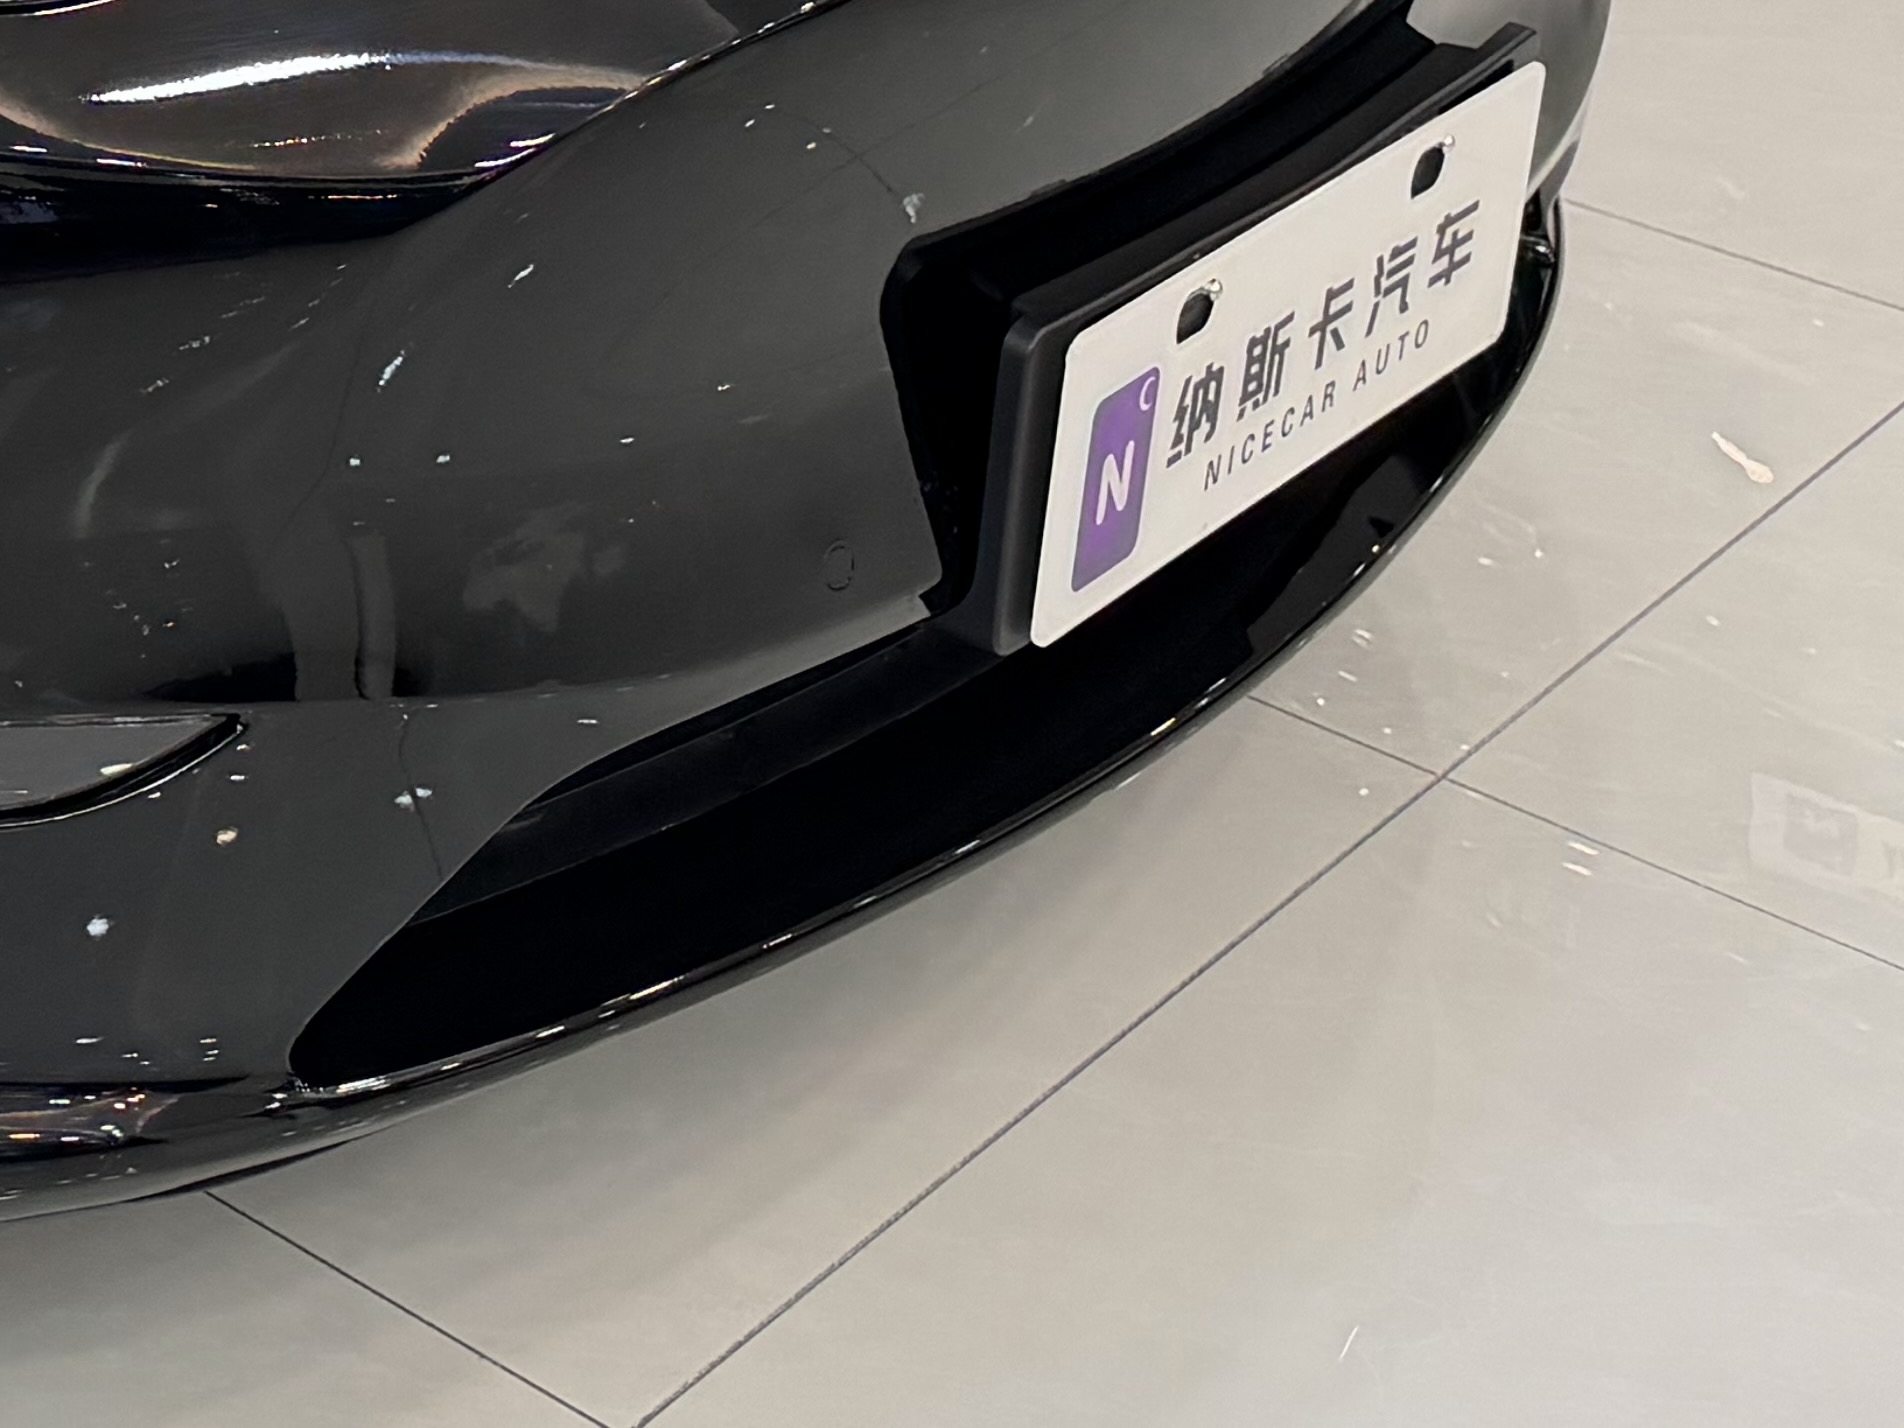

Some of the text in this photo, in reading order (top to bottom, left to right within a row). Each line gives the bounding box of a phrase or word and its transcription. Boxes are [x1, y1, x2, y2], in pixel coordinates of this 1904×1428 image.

[1166, 200, 1480, 469] 纳斯卡汽车
[1204, 319, 1429, 492] NICECAR AUTO
